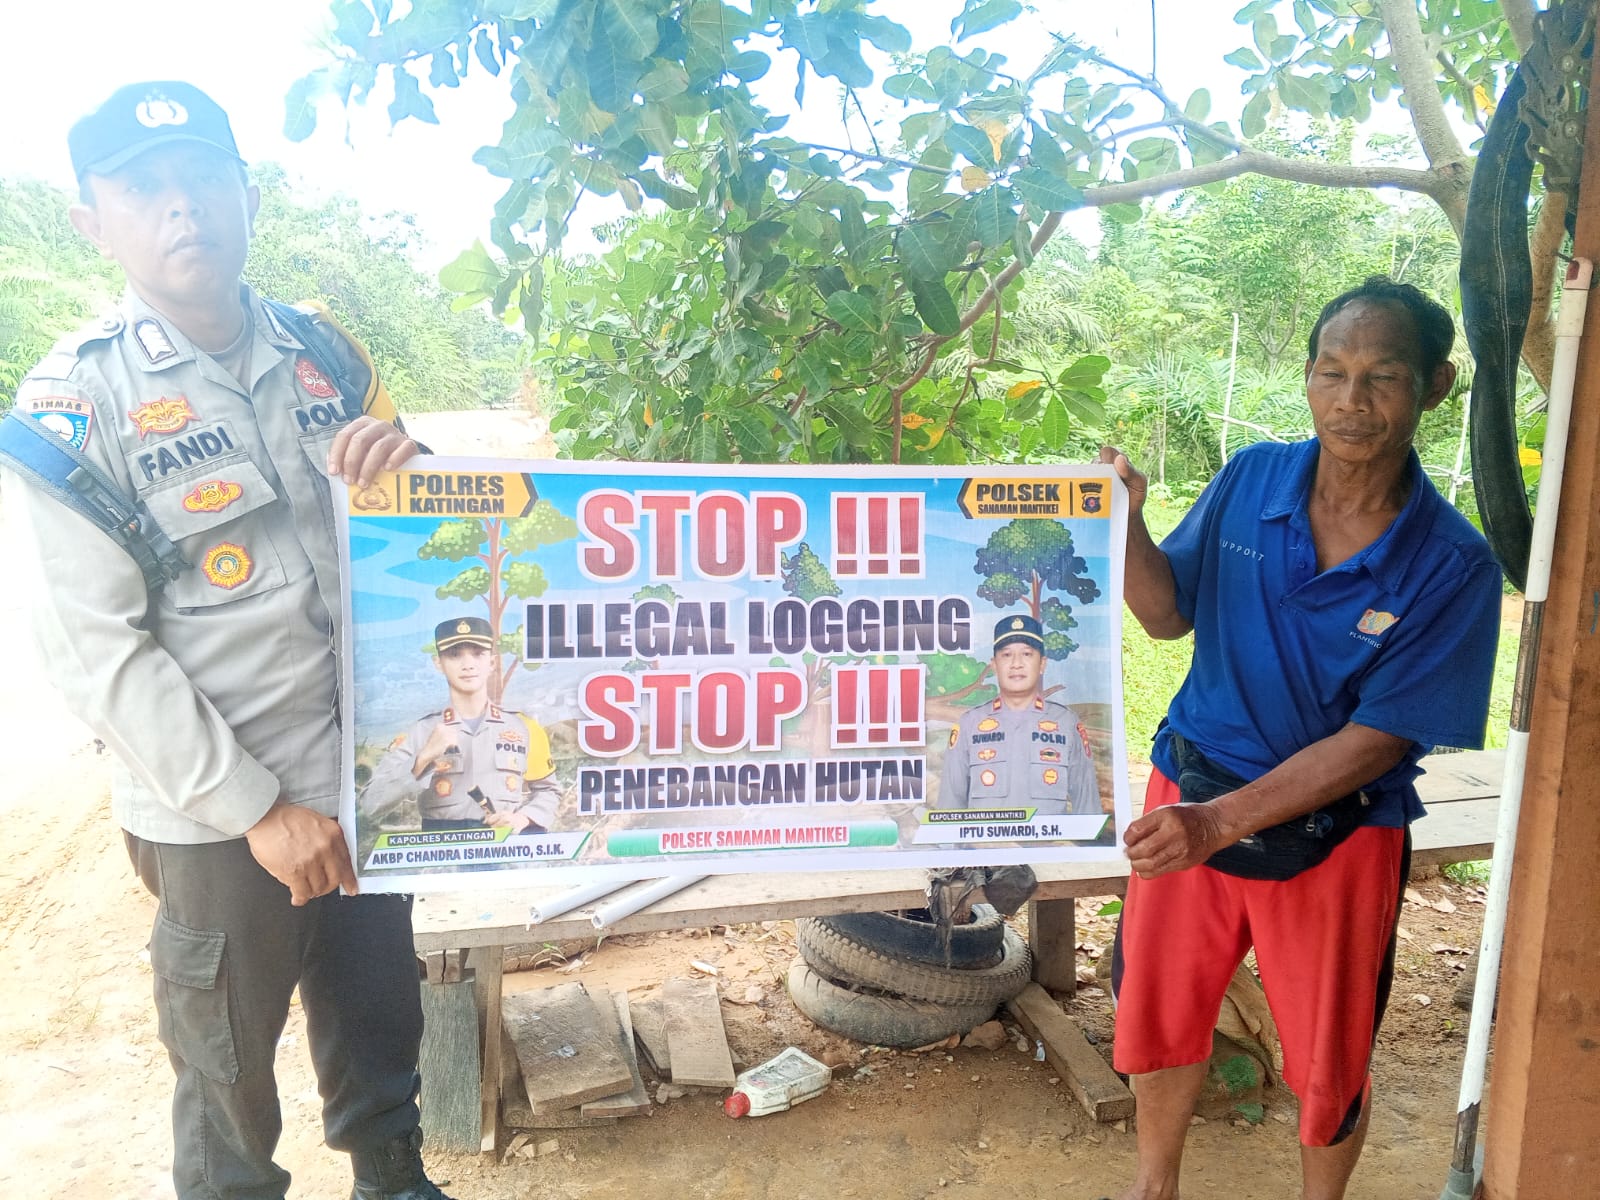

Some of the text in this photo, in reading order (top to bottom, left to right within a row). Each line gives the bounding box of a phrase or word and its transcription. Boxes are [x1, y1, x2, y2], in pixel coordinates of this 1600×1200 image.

[138, 426, 235, 482] FANDI
[409, 473, 505, 497] POLRES
[976, 483, 1061, 502] POLSEK
[409, 497, 505, 514] KATINGAN
[1020, 503, 1060, 515] MANTIKEI
[582, 492, 921, 579] STOP !!!
[525, 598, 971, 659] ILLEGAL LOGGING
[582, 668, 921, 754] STOP !!!
[972, 731, 1006, 745] SUWARDI
[1031, 731, 1066, 745] POLRI
[580, 759, 923, 813] PENEBANGAN HUTAN
[930, 812, 963, 821] KAPOLSEK
[995, 810, 1025, 820] MANTIKEI
[388, 831, 495, 846] KAPOLRES KATINGAN
[662, 826, 848, 850] POLSEK SANAMAN MANTIKEI
[959, 824, 1063, 839] IPTU SUWARDI, S.H.
[372, 843, 565, 866] AKBP CHANDRA ISMAWANTO, S.I.K.
